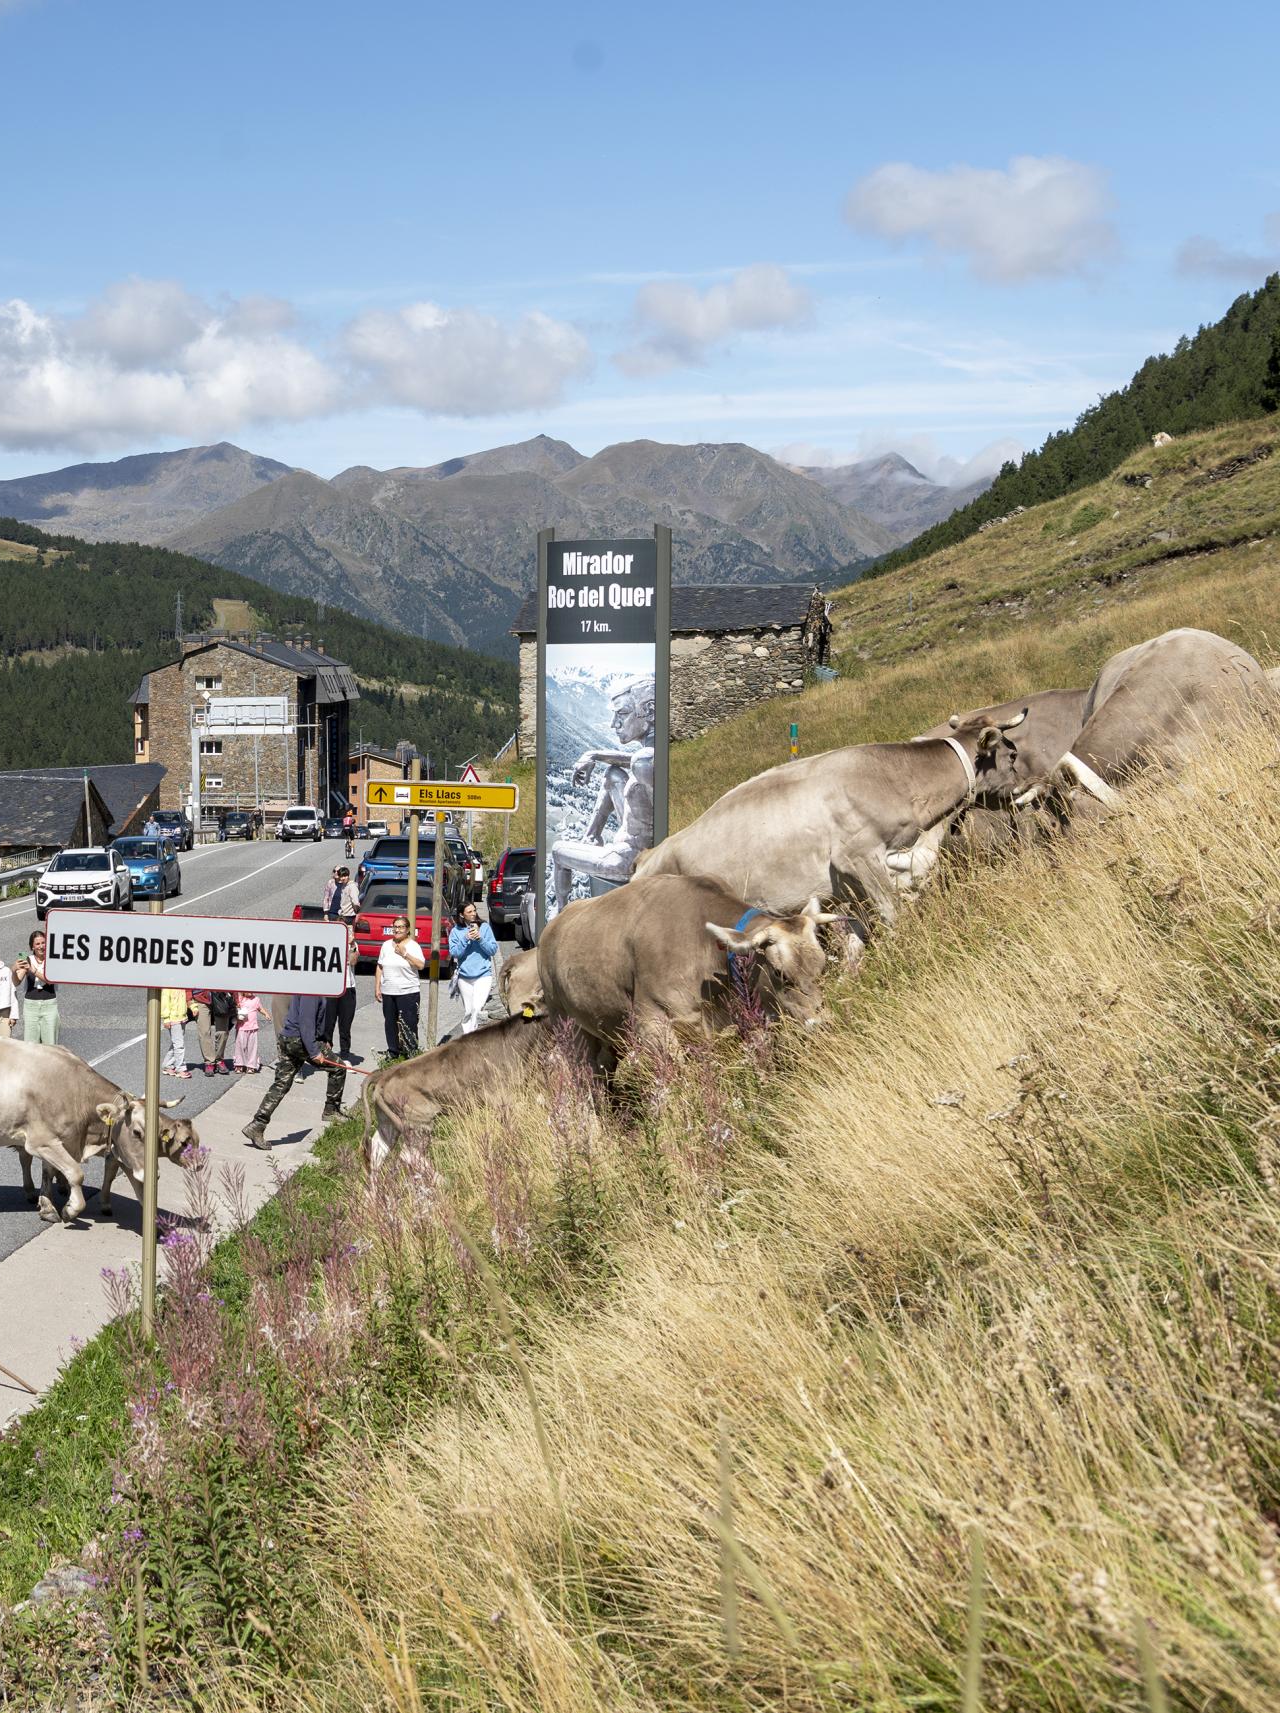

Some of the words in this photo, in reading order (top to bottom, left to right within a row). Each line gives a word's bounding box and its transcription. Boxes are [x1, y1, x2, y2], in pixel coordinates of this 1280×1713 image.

[562, 551, 634, 575] Mirador
[548, 585, 575, 608] Roc
[578, 586, 604, 608] del
[608, 583, 654, 610] Quer
[580, 620, 591, 632] 17
[593, 620, 612, 632] km.
[419, 789, 433, 799] Els
[436, 789, 461, 800] Llacs
[48, 933, 90, 961] LES
[99, 935, 194, 967] BORDES
